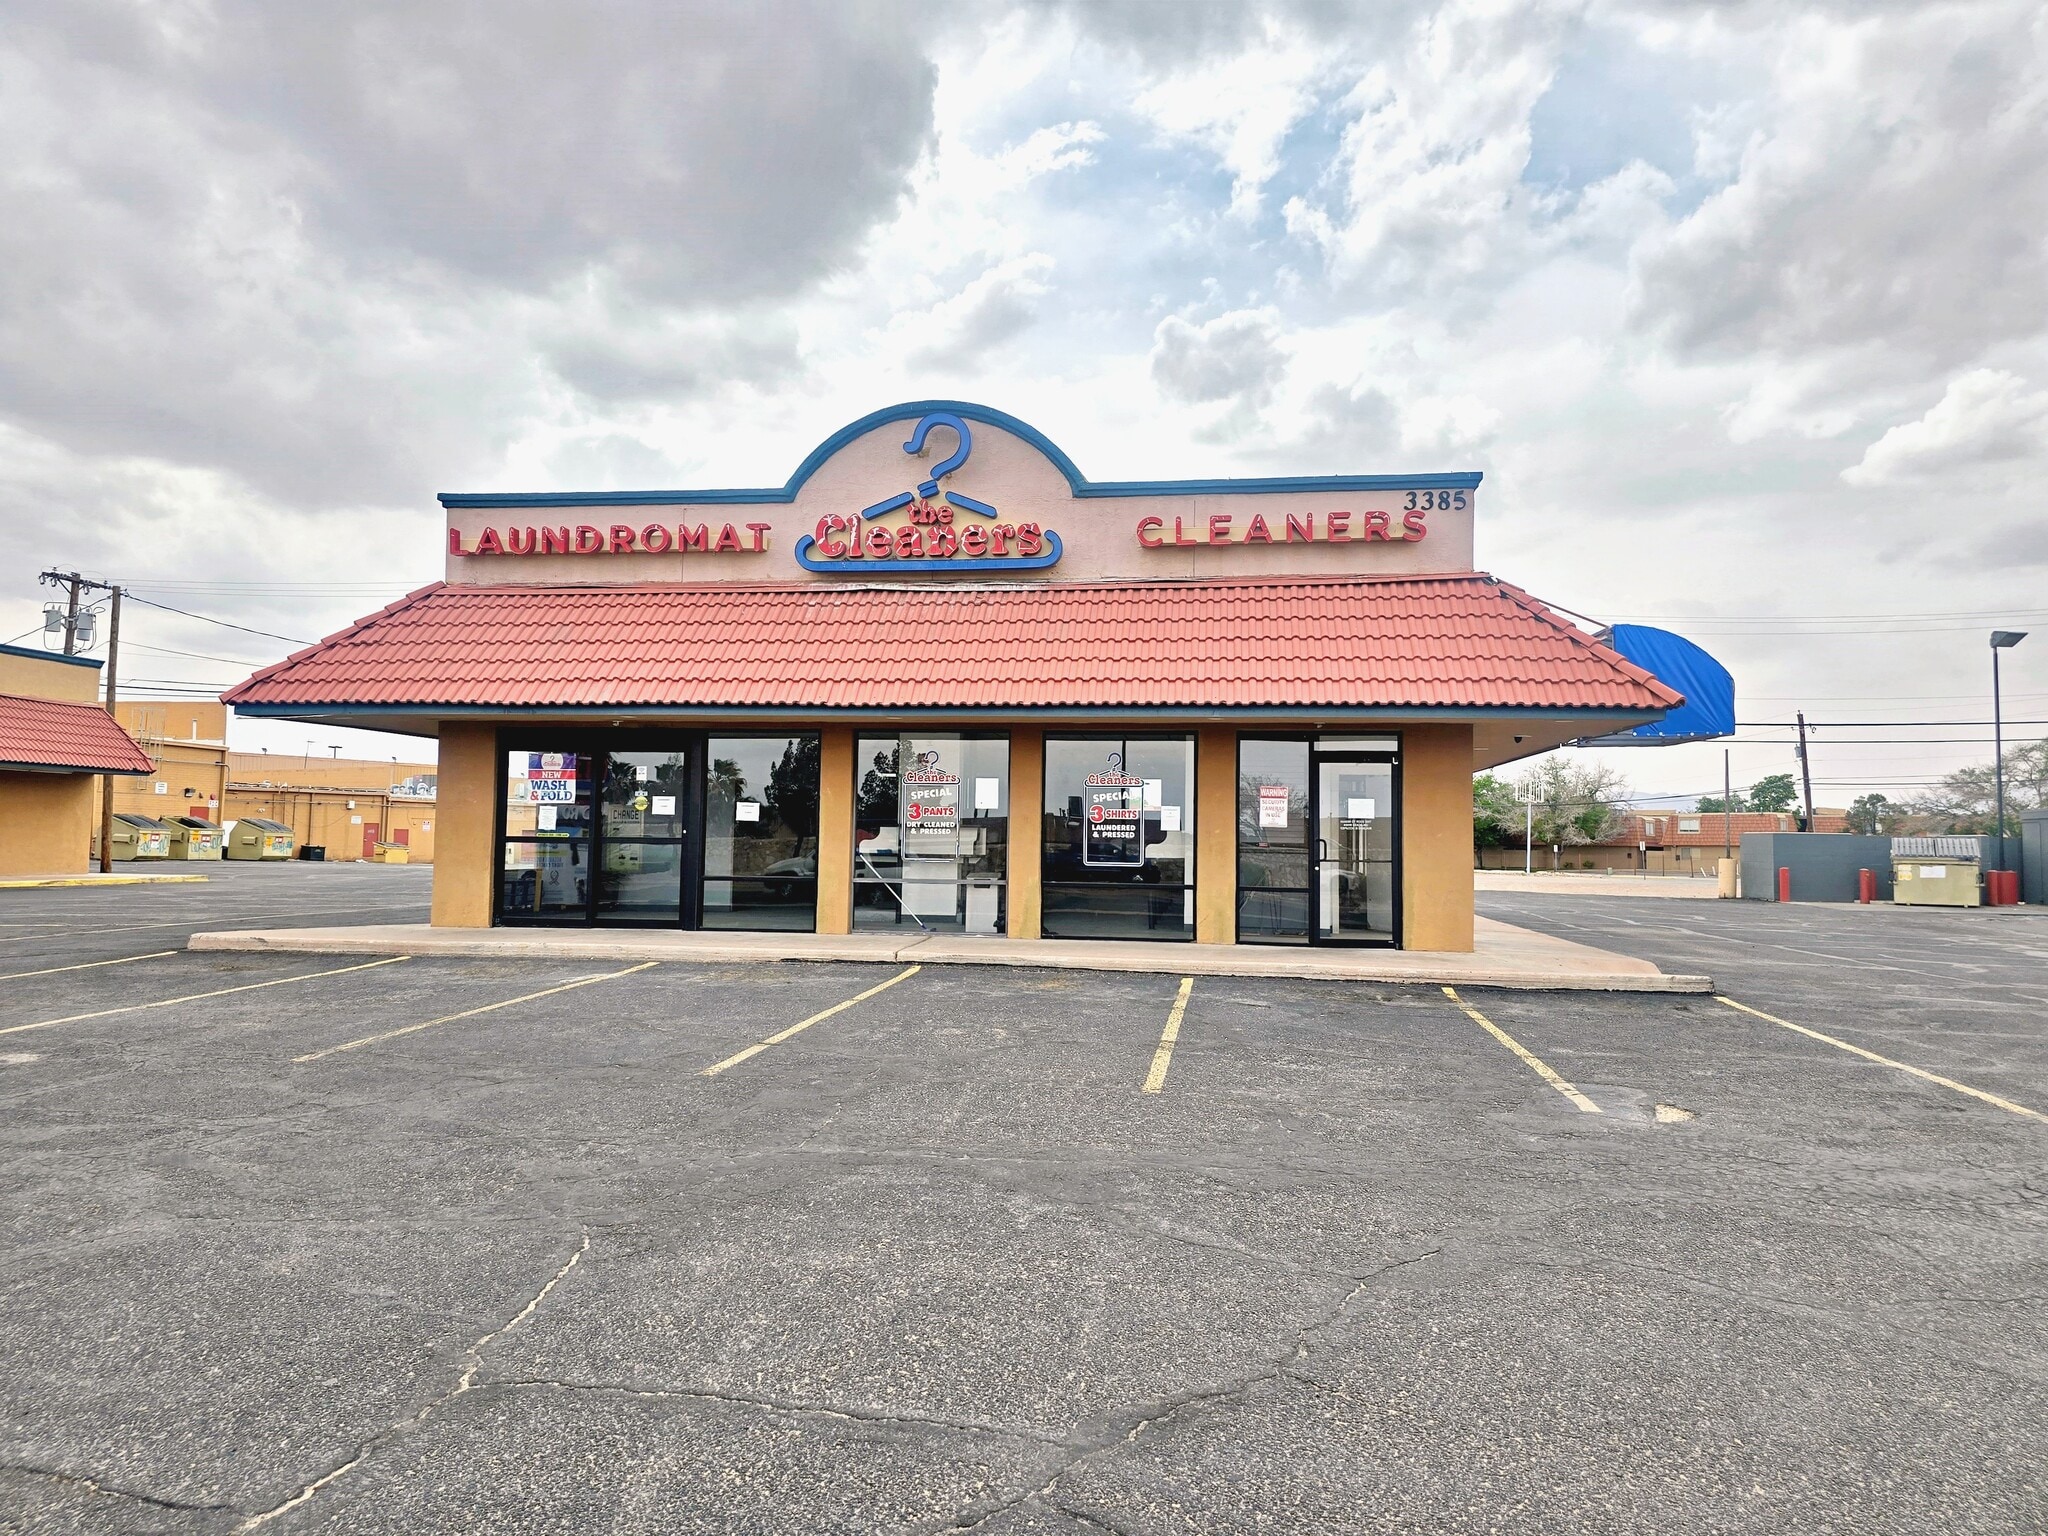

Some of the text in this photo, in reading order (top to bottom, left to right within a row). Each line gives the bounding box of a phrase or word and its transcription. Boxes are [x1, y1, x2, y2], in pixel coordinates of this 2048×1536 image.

[1403, 489, 1466, 511] 3385
[906, 498, 954, 525] the
[815, 513, 1043, 557] Cleaners
[1136, 510, 1427, 548] CLEANERS
[449, 523, 772, 556] LAUNDROMAT
[542, 770, 563, 779] NEW
[906, 772, 957, 782] Cleaners
[1088, 774, 1141, 785] Cleaners
[531, 780, 568, 791] WASH
[1260, 788, 1288, 796] WARNING
[530, 790, 540, 801] &
[910, 787, 952, 800] SPECIAL
[613, 810, 639, 820] CHANGE
[907, 803, 955, 820] 3 PANTS
[1090, 805, 1137, 823] 3 SHIRTS
